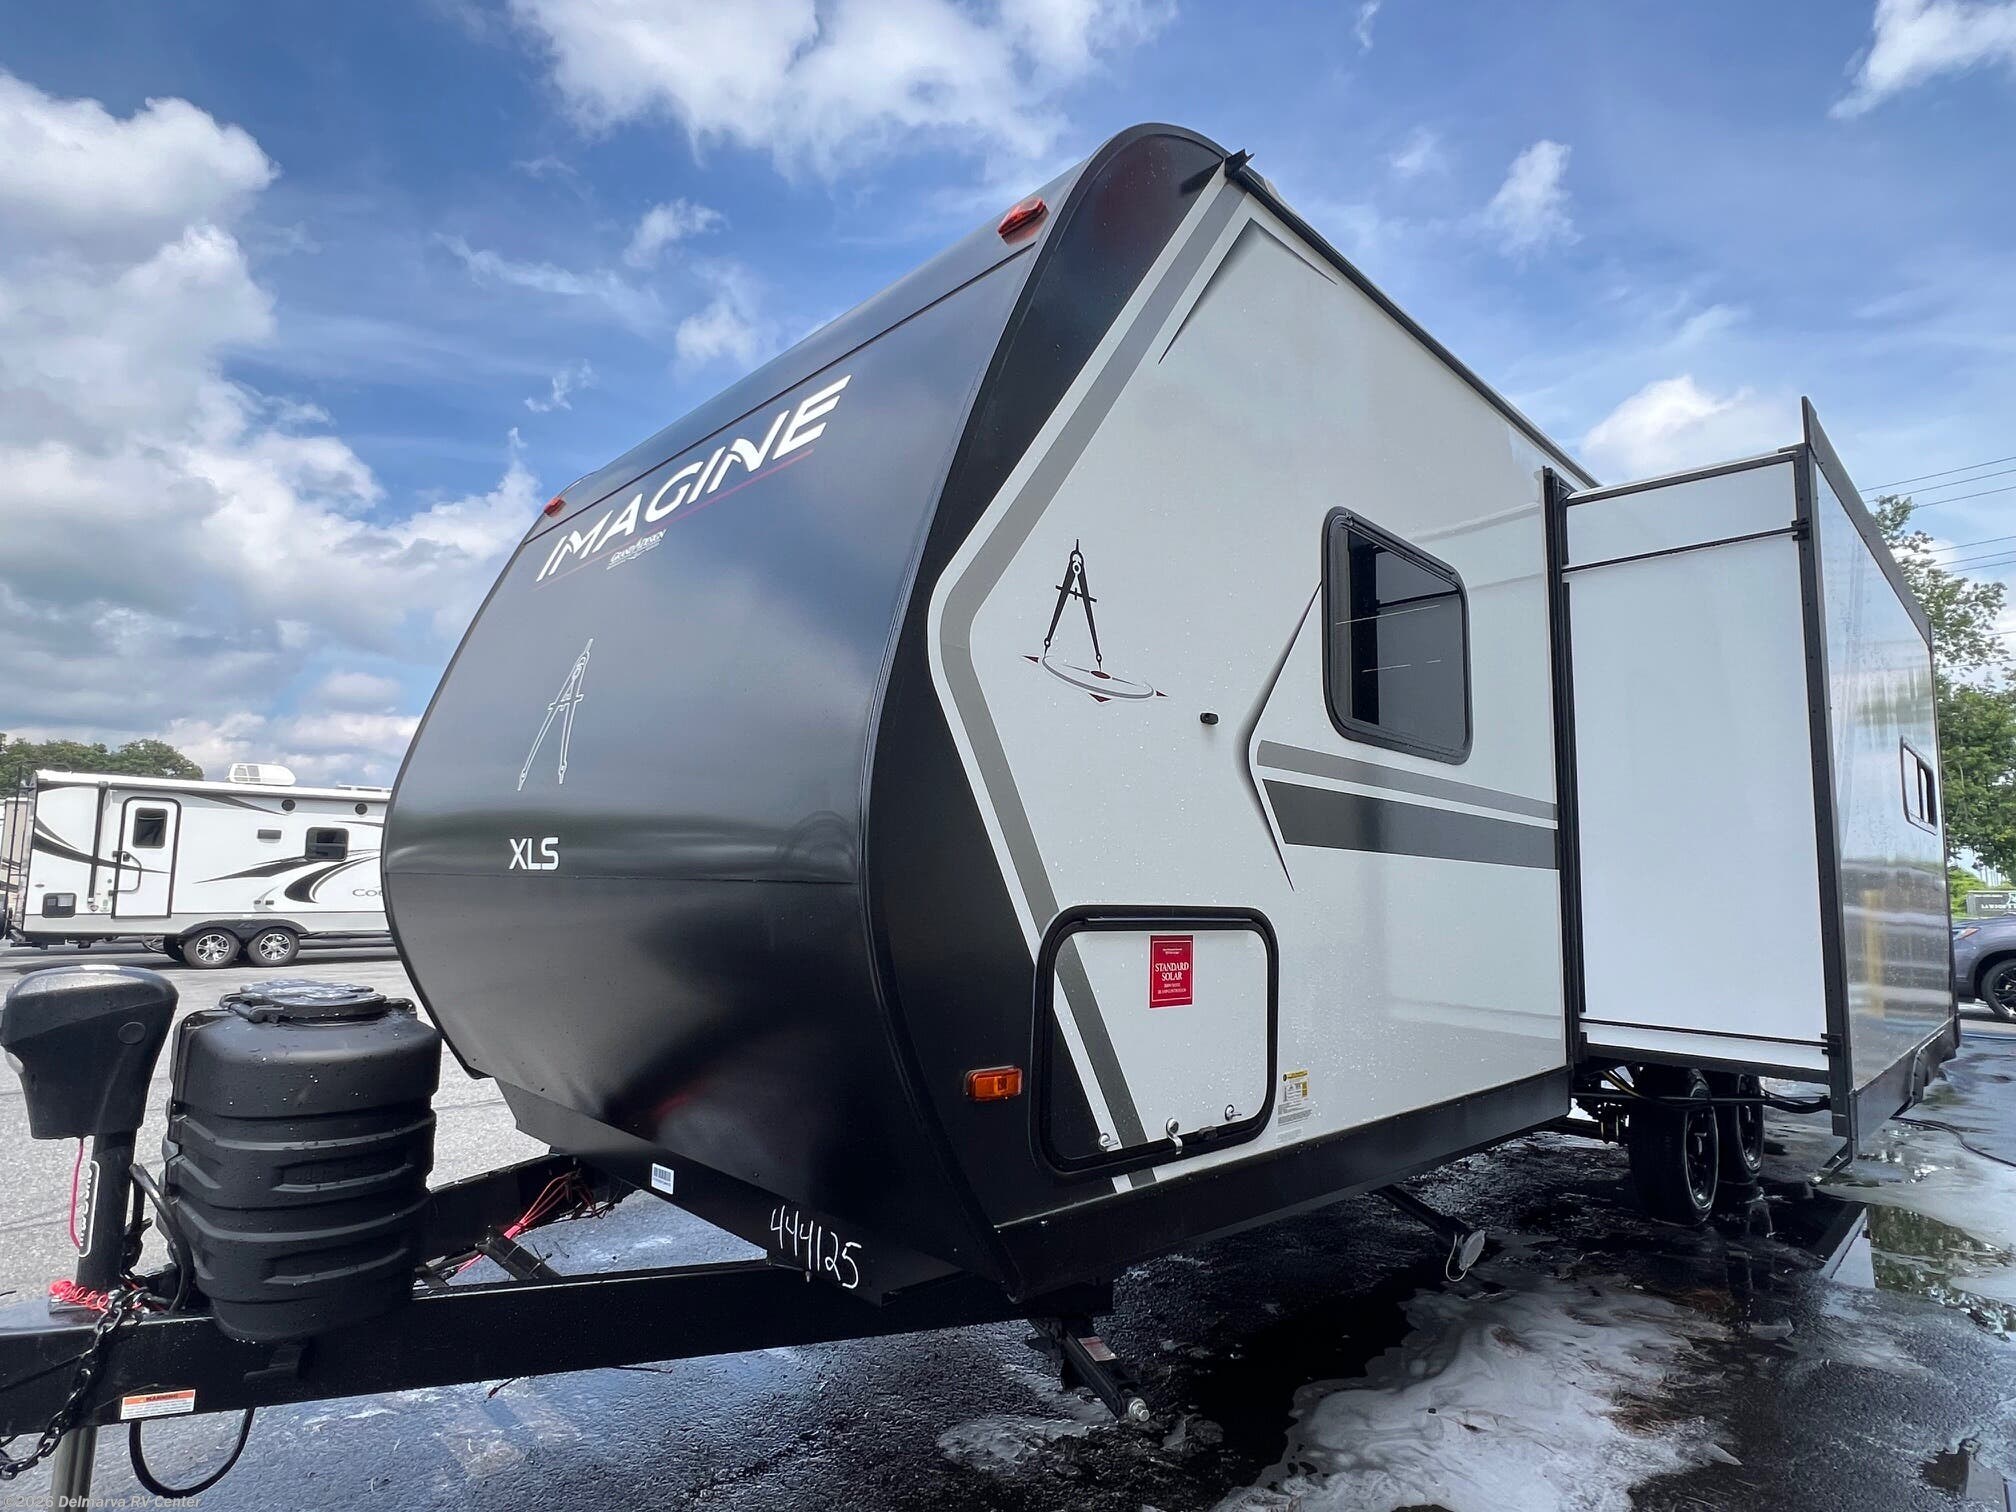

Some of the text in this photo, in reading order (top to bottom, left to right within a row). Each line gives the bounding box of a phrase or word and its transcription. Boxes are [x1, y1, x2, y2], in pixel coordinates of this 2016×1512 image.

[535, 374, 852, 582] IMAGINE
[508, 836, 560, 871] XLS
[1154, 961, 1190, 973] STANDARD
[1161, 971, 1183, 982] SOLAR
[769, 1204, 862, 1289] 444125
